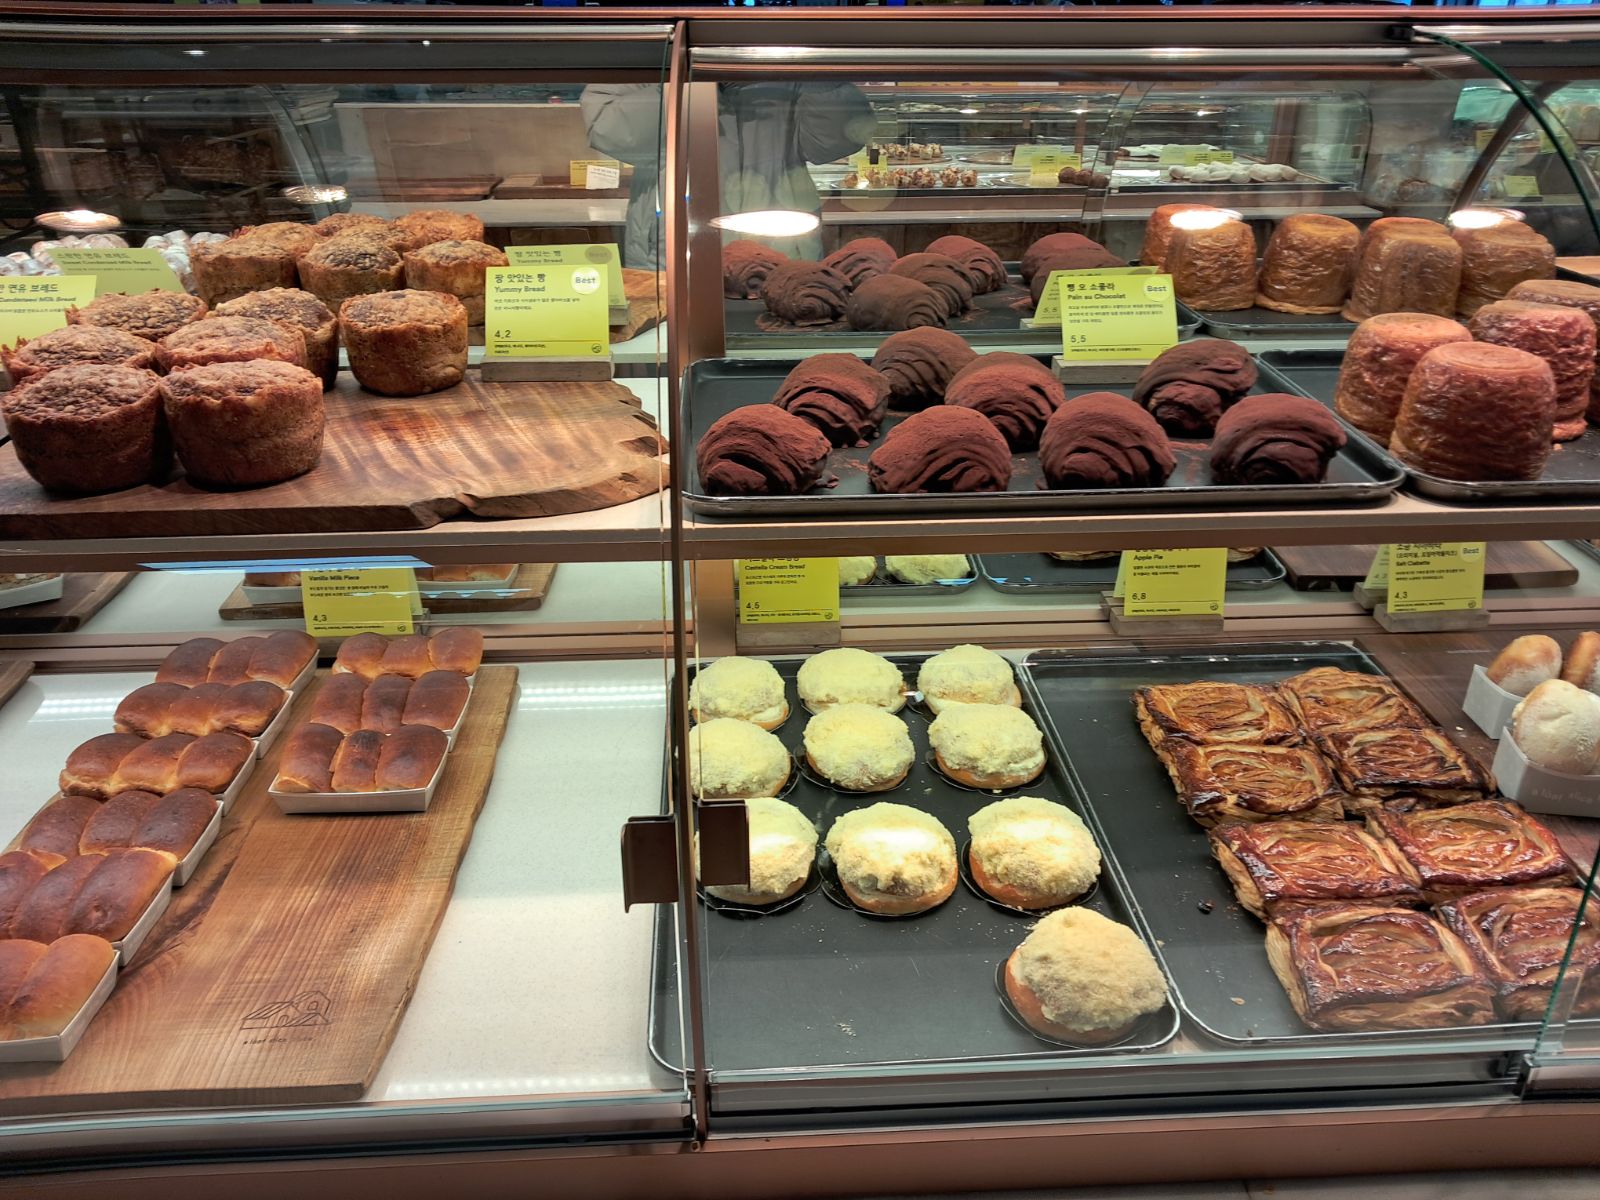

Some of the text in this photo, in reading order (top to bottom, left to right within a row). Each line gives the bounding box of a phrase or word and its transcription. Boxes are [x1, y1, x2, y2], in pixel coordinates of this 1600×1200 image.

[507, 273, 534, 283] 맛있는
[537, 273, 546, 283] 빵
[575, 276, 596, 284] Best
[8, 283, 27, 294] 연유
[30, 283, 59, 293] 브레드
[494, 285, 546, 294] Yummy Bread
[1146, 285, 1168, 293] Best
